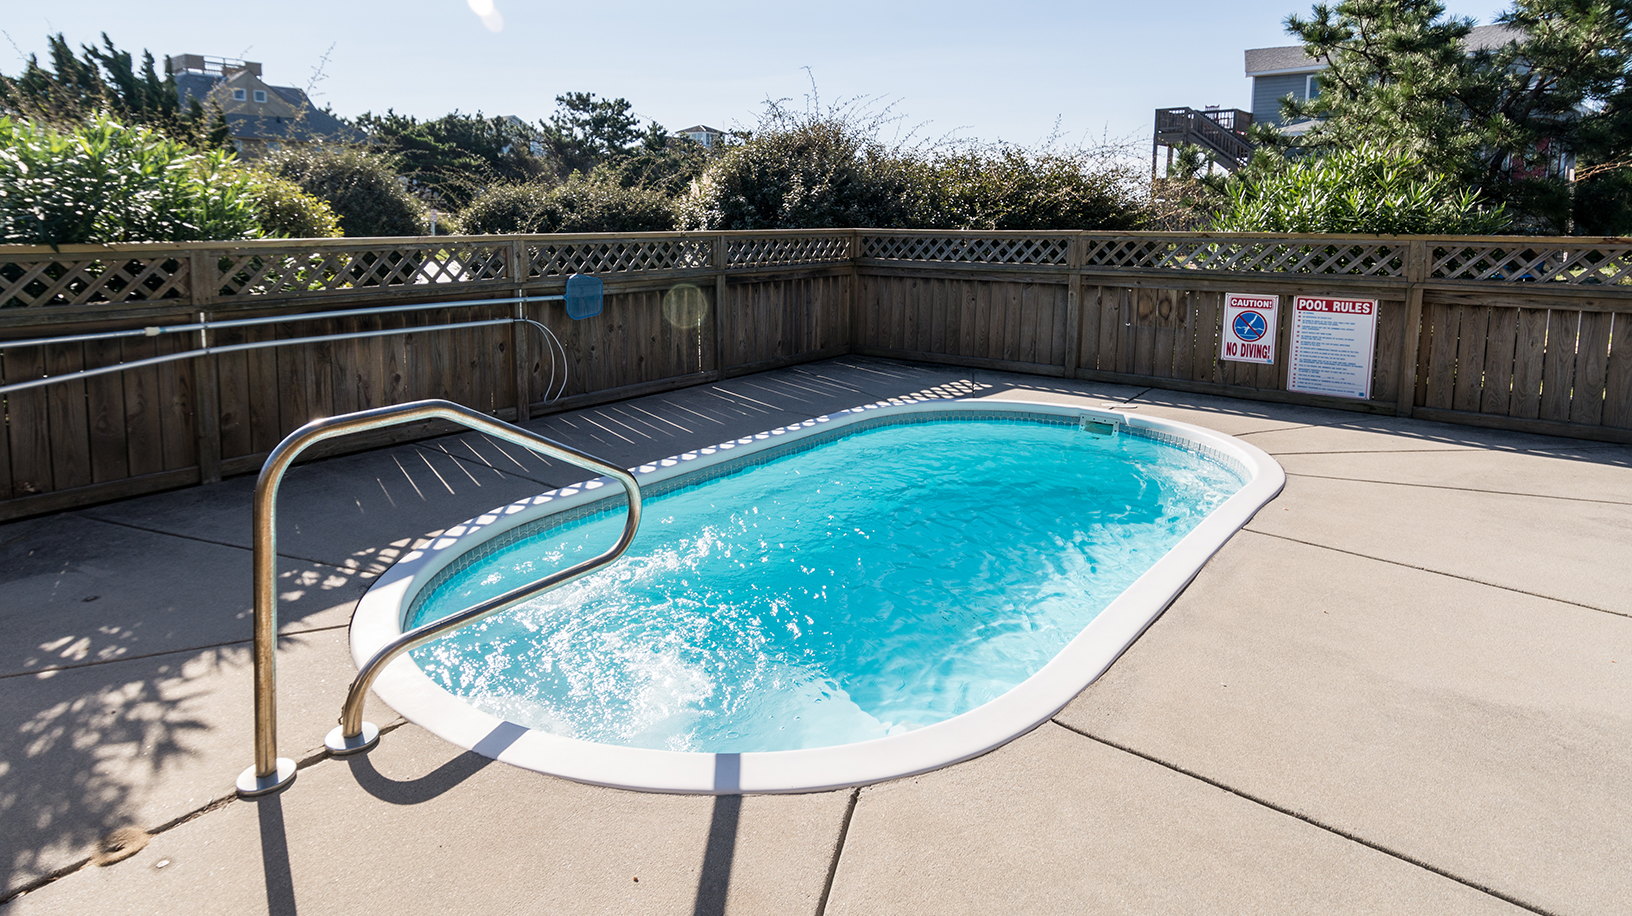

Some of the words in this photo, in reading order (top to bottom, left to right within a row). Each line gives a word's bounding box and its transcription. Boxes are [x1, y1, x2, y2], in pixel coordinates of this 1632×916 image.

[1231, 299, 1272, 308] CAUTION!
[1299, 299, 1328, 311] POOL
[1332, 301, 1370, 314] RULES
[1226, 341, 1238, 356] NO
[1240, 342, 1271, 359] DIVING!
